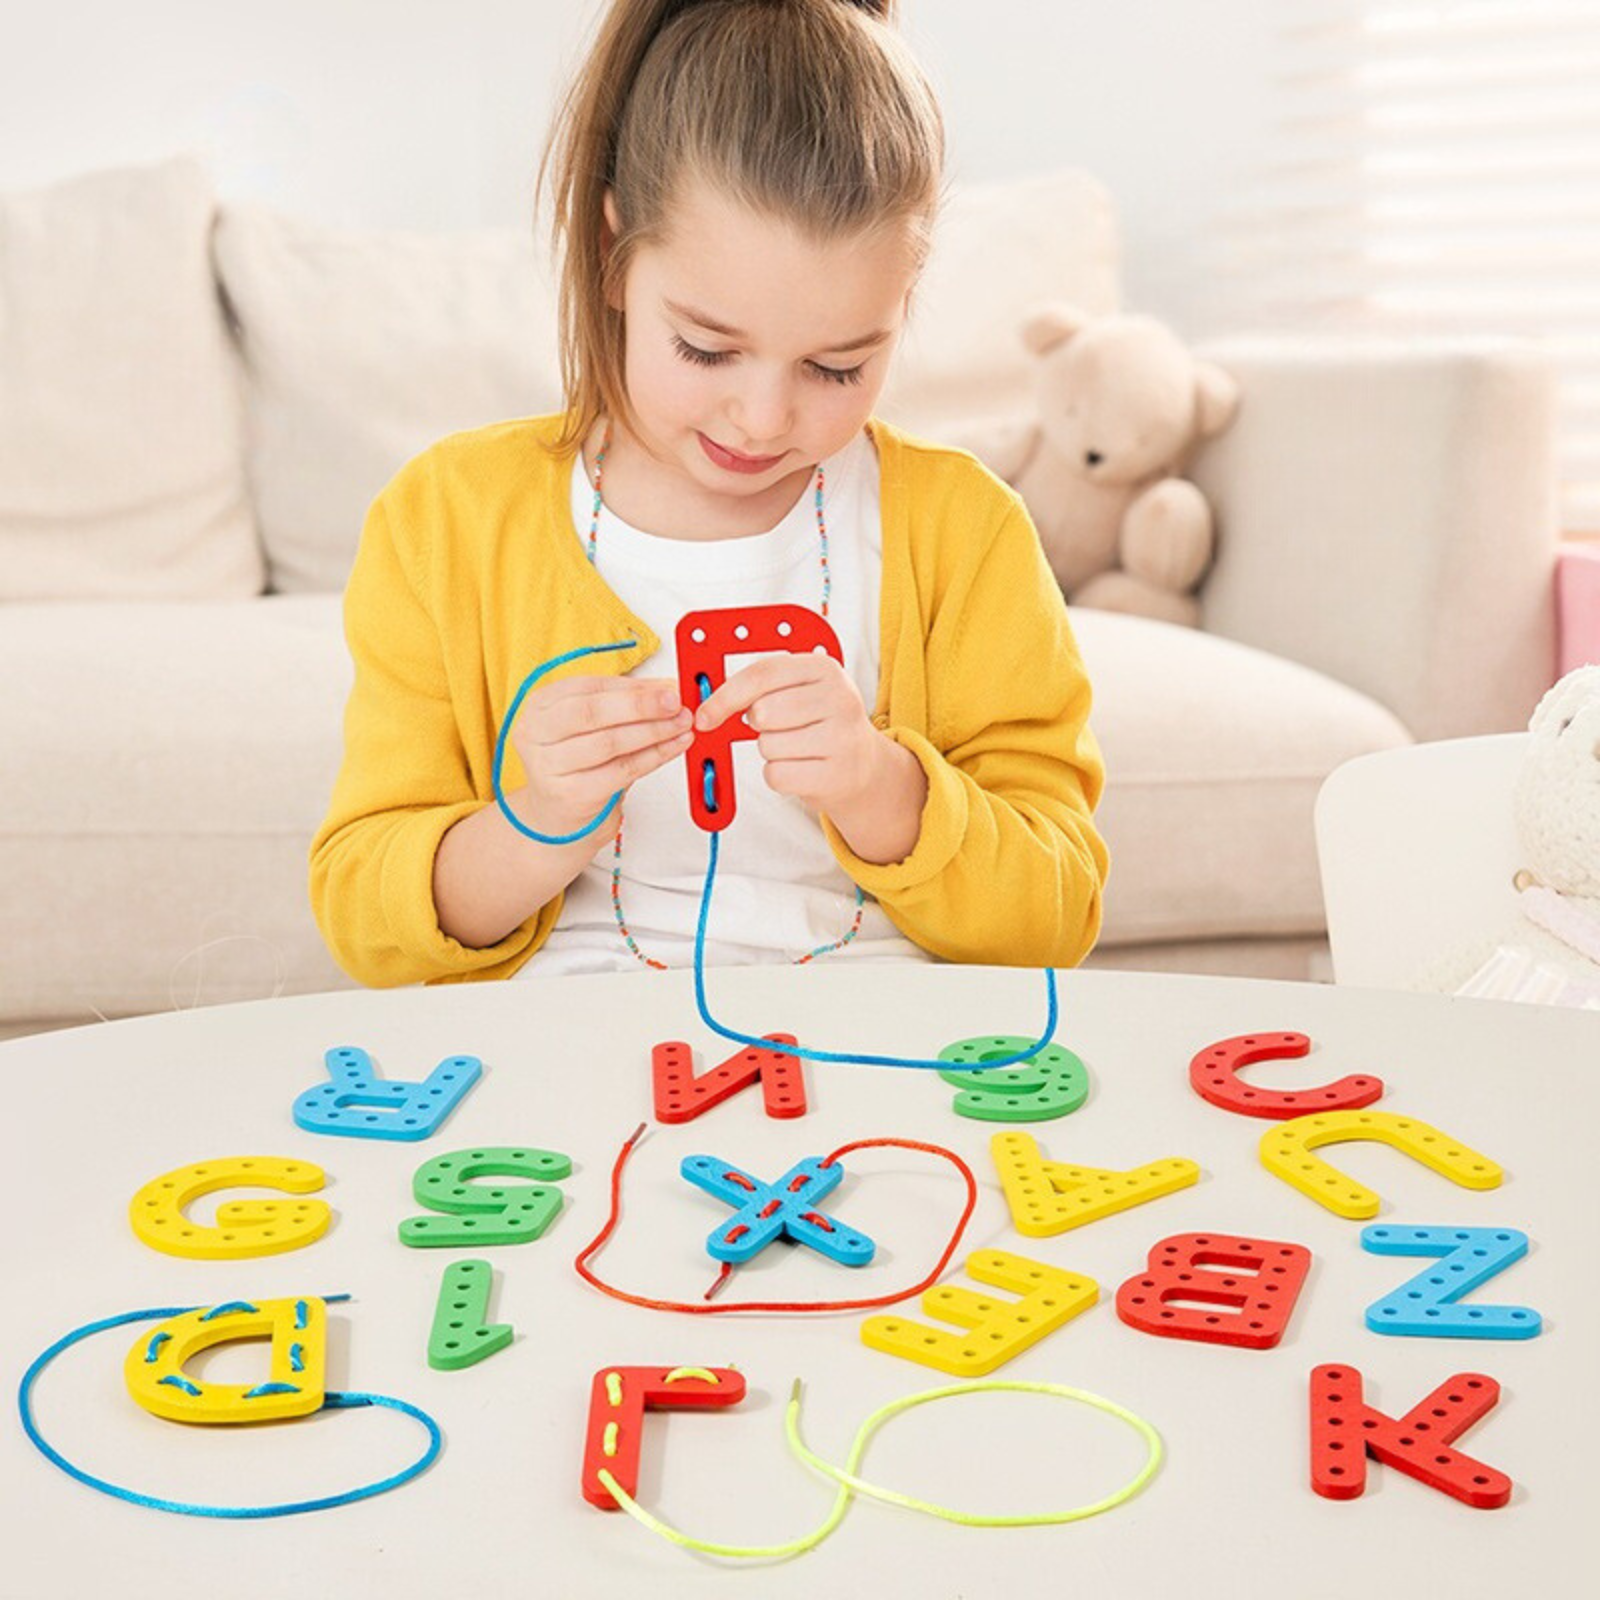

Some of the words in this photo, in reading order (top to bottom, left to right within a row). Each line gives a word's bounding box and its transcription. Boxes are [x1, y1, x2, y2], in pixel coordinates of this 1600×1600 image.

[674, 603, 844, 832] P
[293, 1046, 483, 1142] R
[1190, 1031, 1384, 1119] C
[130, 1156, 332, 1260] G
[680, 1155, 875, 1267] X
[990, 1131, 1200, 1238] A
[861, 1249, 1100, 1377] E
[1115, 1233, 1312, 1350] B
[1360, 1224, 1542, 1340] Z
[124, 1296, 326, 1424] D
[1310, 1363, 1512, 1509] K
